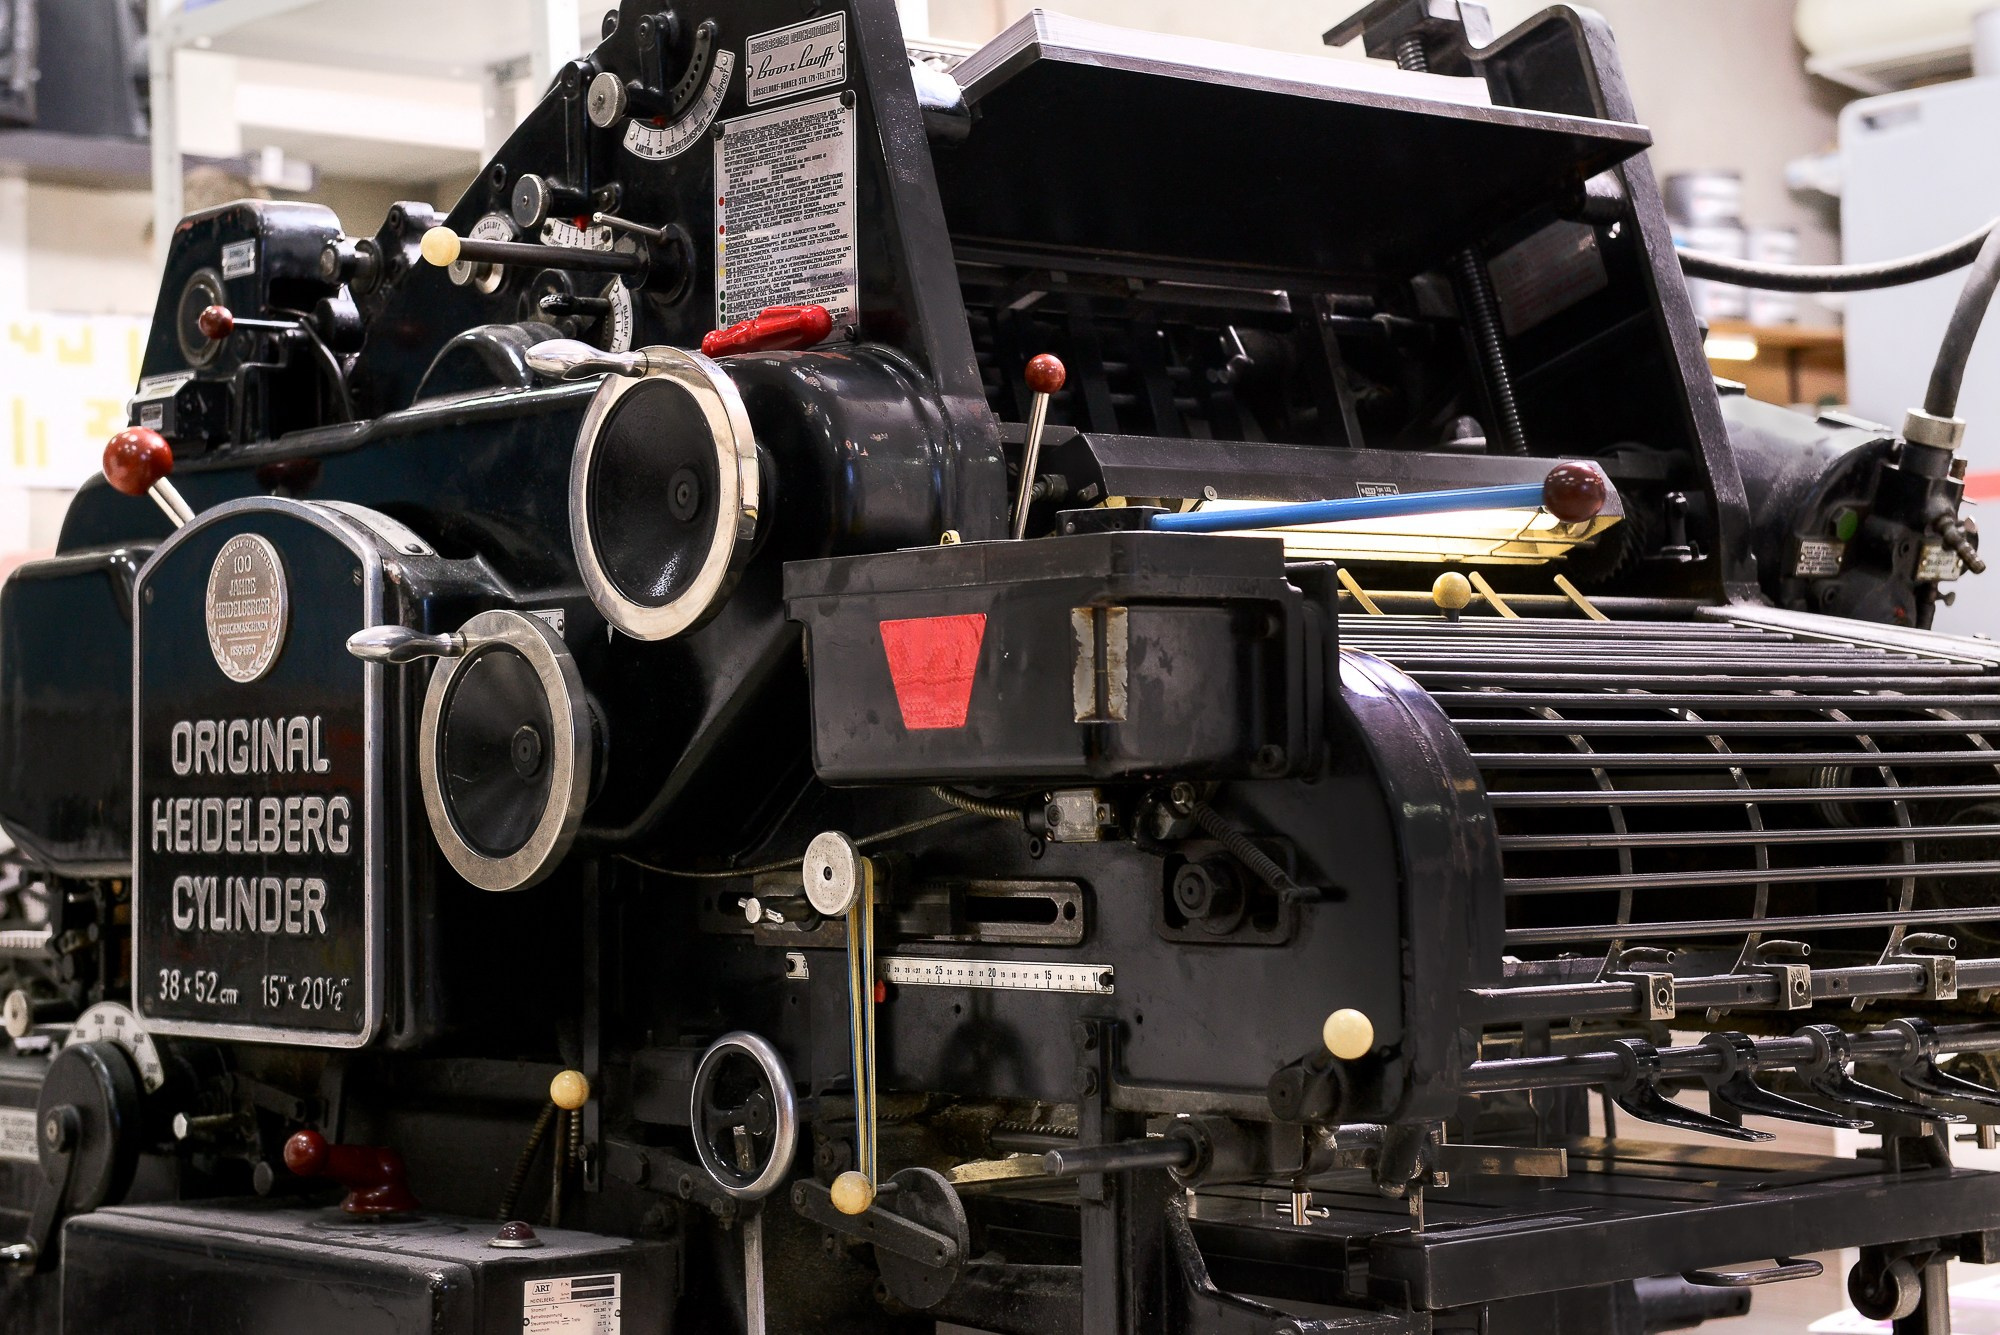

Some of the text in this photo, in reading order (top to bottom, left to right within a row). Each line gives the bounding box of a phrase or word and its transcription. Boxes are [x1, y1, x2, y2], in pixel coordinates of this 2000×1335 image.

[635, 142, 653, 156] KARTON
[665, 117, 706, 155] PAPIERTRANSPORT
[234, 554, 252, 574] 100
[229, 577, 256, 596] JAHRE
[216, 597, 270, 619] HEIDELBERGER
[218, 620, 268, 635] DRUCKMASCHINEN
[171, 715, 330, 775] ORIGINAL
[152, 796, 350, 854] HEIDELBERG
[172, 875, 327, 934] CYLINDER
[159, 968, 181, 1001] 38
[883, 963, 890, 972] 30
[935, 965, 943, 975] 25
[988, 968, 996, 978] 20
[1045, 970, 1052, 980] 15
[1093, 972, 1098, 982] 11
